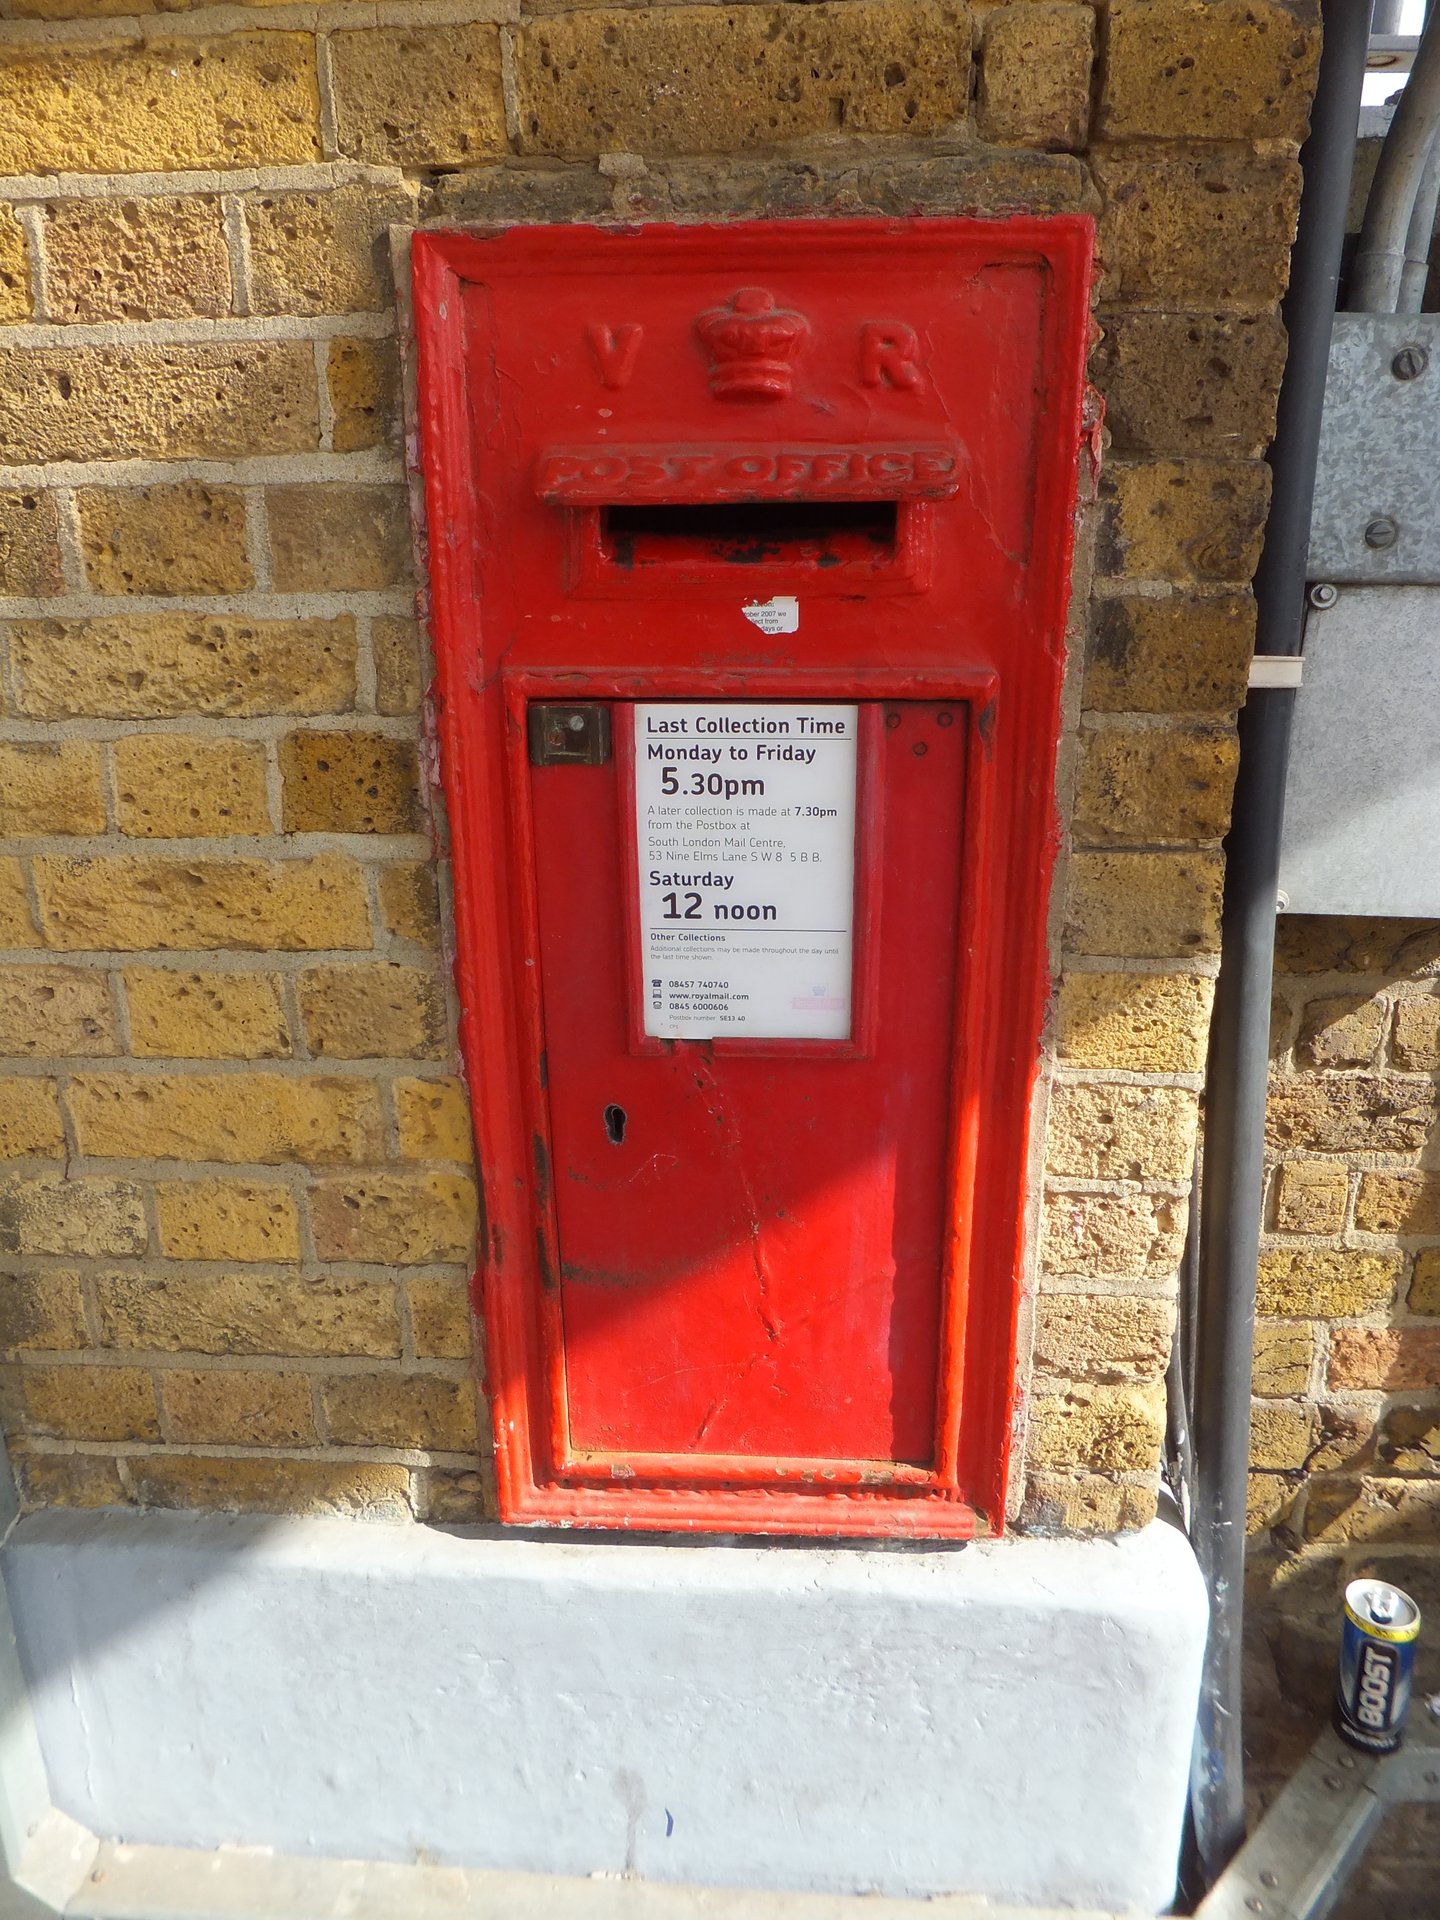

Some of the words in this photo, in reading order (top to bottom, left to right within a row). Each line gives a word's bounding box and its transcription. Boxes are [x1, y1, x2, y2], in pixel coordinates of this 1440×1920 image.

[587, 323, 643, 391] V
[861, 321, 926, 393] R
[544, 455, 714, 486] POST
[725, 452, 959, 483] OFFICE
[647, 717, 688, 734] Last
[696, 717, 790, 734] Collection
[796, 717, 846, 734] Time
[648, 744, 722, 763] Monday
[730, 746, 748, 760] to
[756, 744, 816, 764] Friday
[661, 766, 765, 800] 5.30pm
[648, 806, 655, 815] A
[658, 806, 681, 816] later
[684, 806, 732, 816] collection
[736, 806, 744, 816] is
[748, 806, 776, 816] made
[780, 807, 791, 816] at
[794, 806, 838, 818] 7.30pm
[648, 820, 672, 830] from
[676, 820, 692, 830] the
[696, 820, 737, 830] Postbox
[740, 820, 750, 830] at
[648, 836, 678, 847] South
[682, 837, 720, 847] London
[724, 838, 746, 848] Mail
[749, 838, 786, 849] Centre,
[650, 851, 662, 860] 53
[666, 851, 690, 861] Nine
[694, 851, 718, 862] Elms
[722, 852, 747, 862] Lane
[650, 870, 734, 890] Saturday
[662, 892, 702, 919] 12
[714, 904, 776, 920] noon
[650, 933, 675, 941] Other
[678, 933, 726, 942] Collections
[669, 992, 749, 1001] www.royalmail.com
[1358, 1646, 1393, 1727] BOOST
